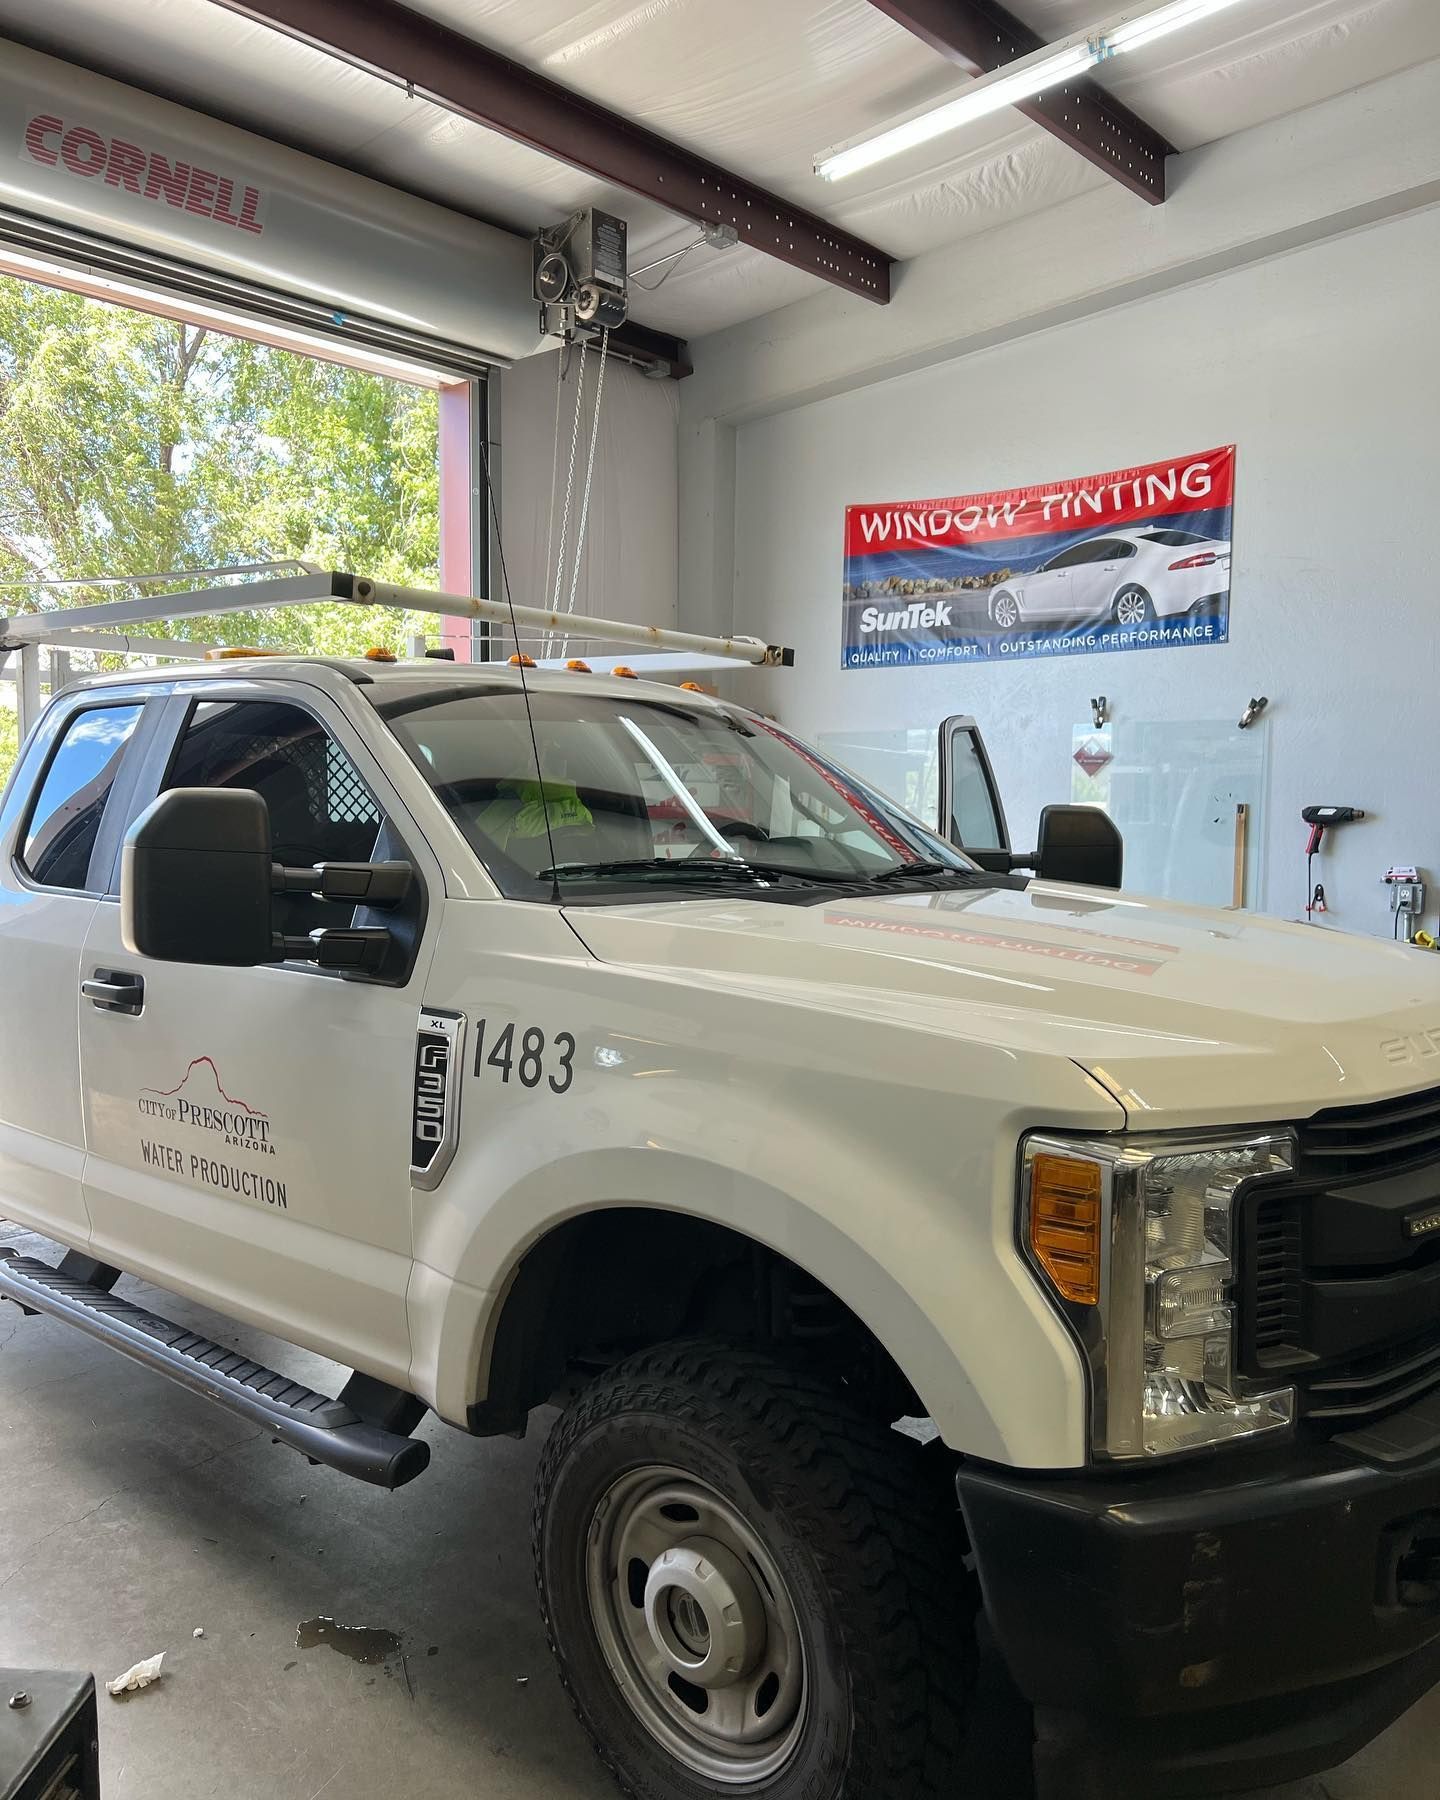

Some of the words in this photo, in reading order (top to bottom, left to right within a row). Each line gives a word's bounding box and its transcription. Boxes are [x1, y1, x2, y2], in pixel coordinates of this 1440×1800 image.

[25, 114, 263, 234] CORNELL
[860, 499, 1027, 543] WINDOW
[1041, 463, 1212, 521] TINTING
[851, 651, 900, 663] QUALITY
[919, 644, 978, 658] COMFORT
[1000, 635, 1096, 653] OUTSTANDING
[1102, 625, 1213, 645] PERFORMANCE
[859, 600, 953, 633] SunTek
[430, 1020, 445, 1029] XL
[473, 1018, 575, 1094] 1483
[138, 1098, 165, 1118] CITY
[177, 1098, 270, 1143] PRESCOTT
[416, 1044, 448, 1142] F350
[225, 1134, 276, 1155] ARIZONA
[141, 1139, 184, 1175] WATER
[190, 1154, 288, 1209] PRODUCTION
